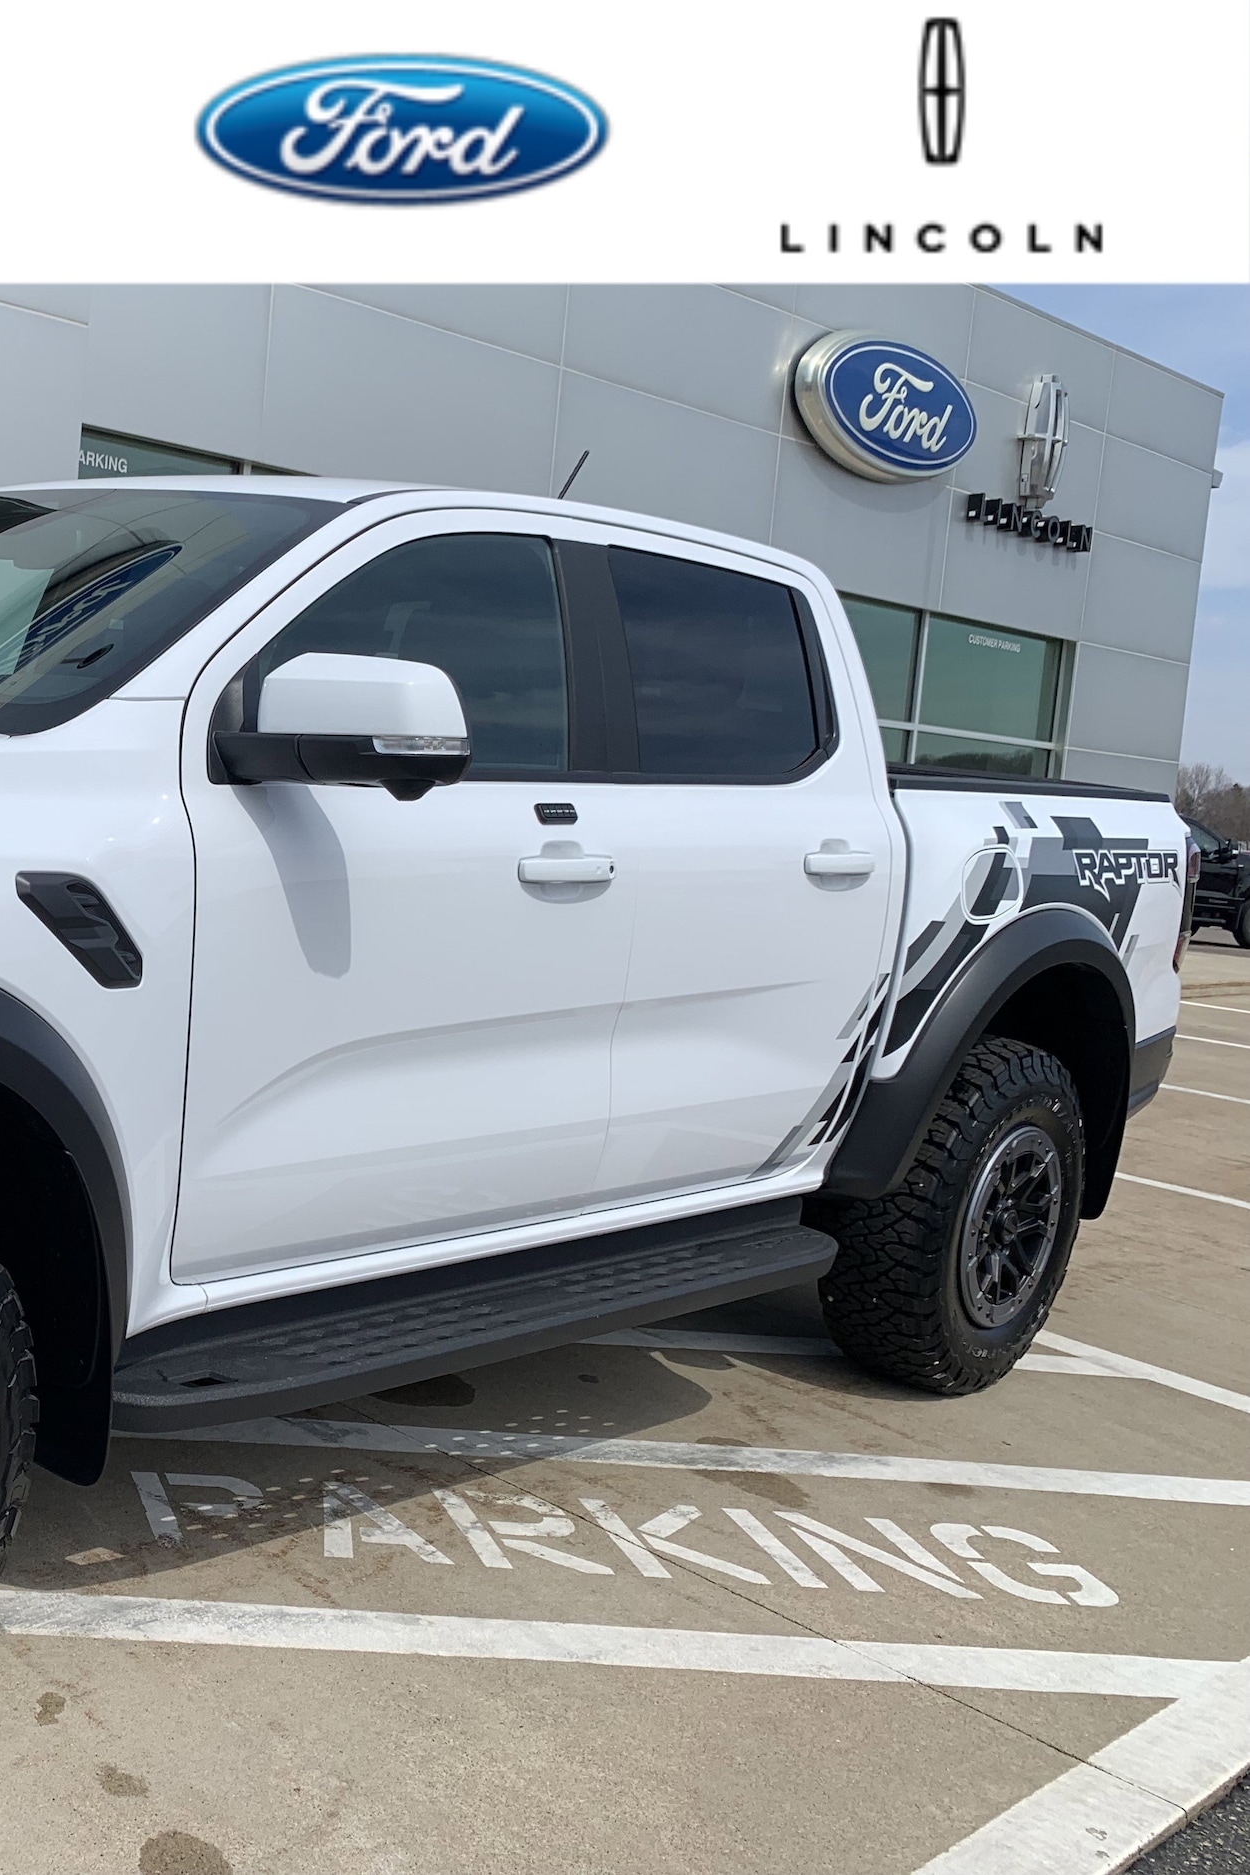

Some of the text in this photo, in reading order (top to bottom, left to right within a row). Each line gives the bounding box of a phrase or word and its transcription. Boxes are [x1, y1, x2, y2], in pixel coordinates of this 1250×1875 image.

[859, 361, 954, 453] Ford
[78, 449, 128, 474] ARKING
[967, 492, 1093, 553] LINCOLN
[968, 633, 1021, 653] CUSTOMER PARKING
[1073, 850, 1182, 902] RAPTOR
[128, 1470, 1120, 1608] PARKING
